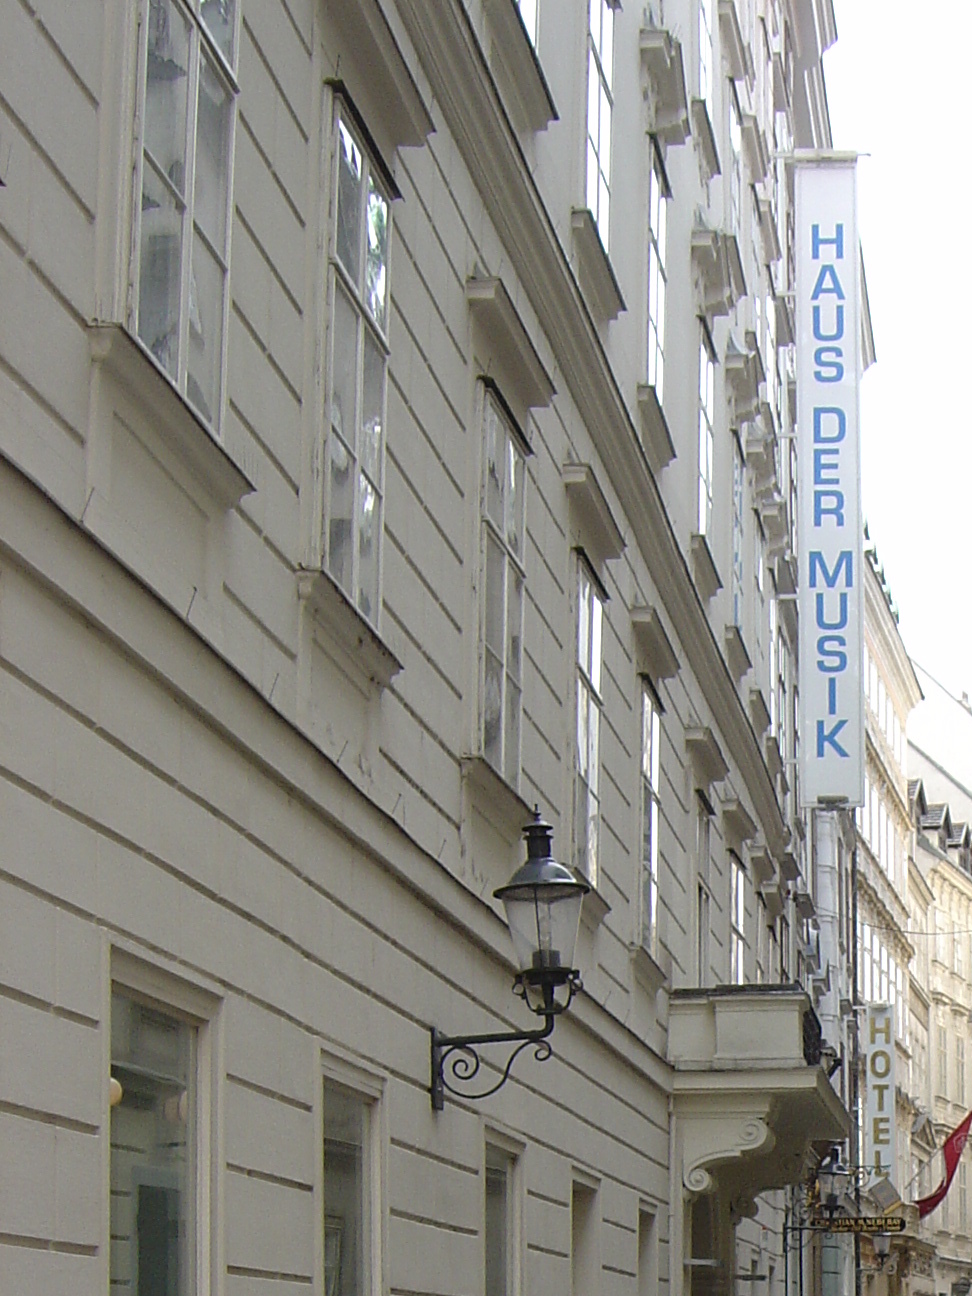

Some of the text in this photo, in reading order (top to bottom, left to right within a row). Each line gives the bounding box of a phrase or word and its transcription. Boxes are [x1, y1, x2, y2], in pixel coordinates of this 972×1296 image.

[808, 222, 853, 759] HAUS DER MUSIK
[869, 1016, 891, 1179] HOTEL
